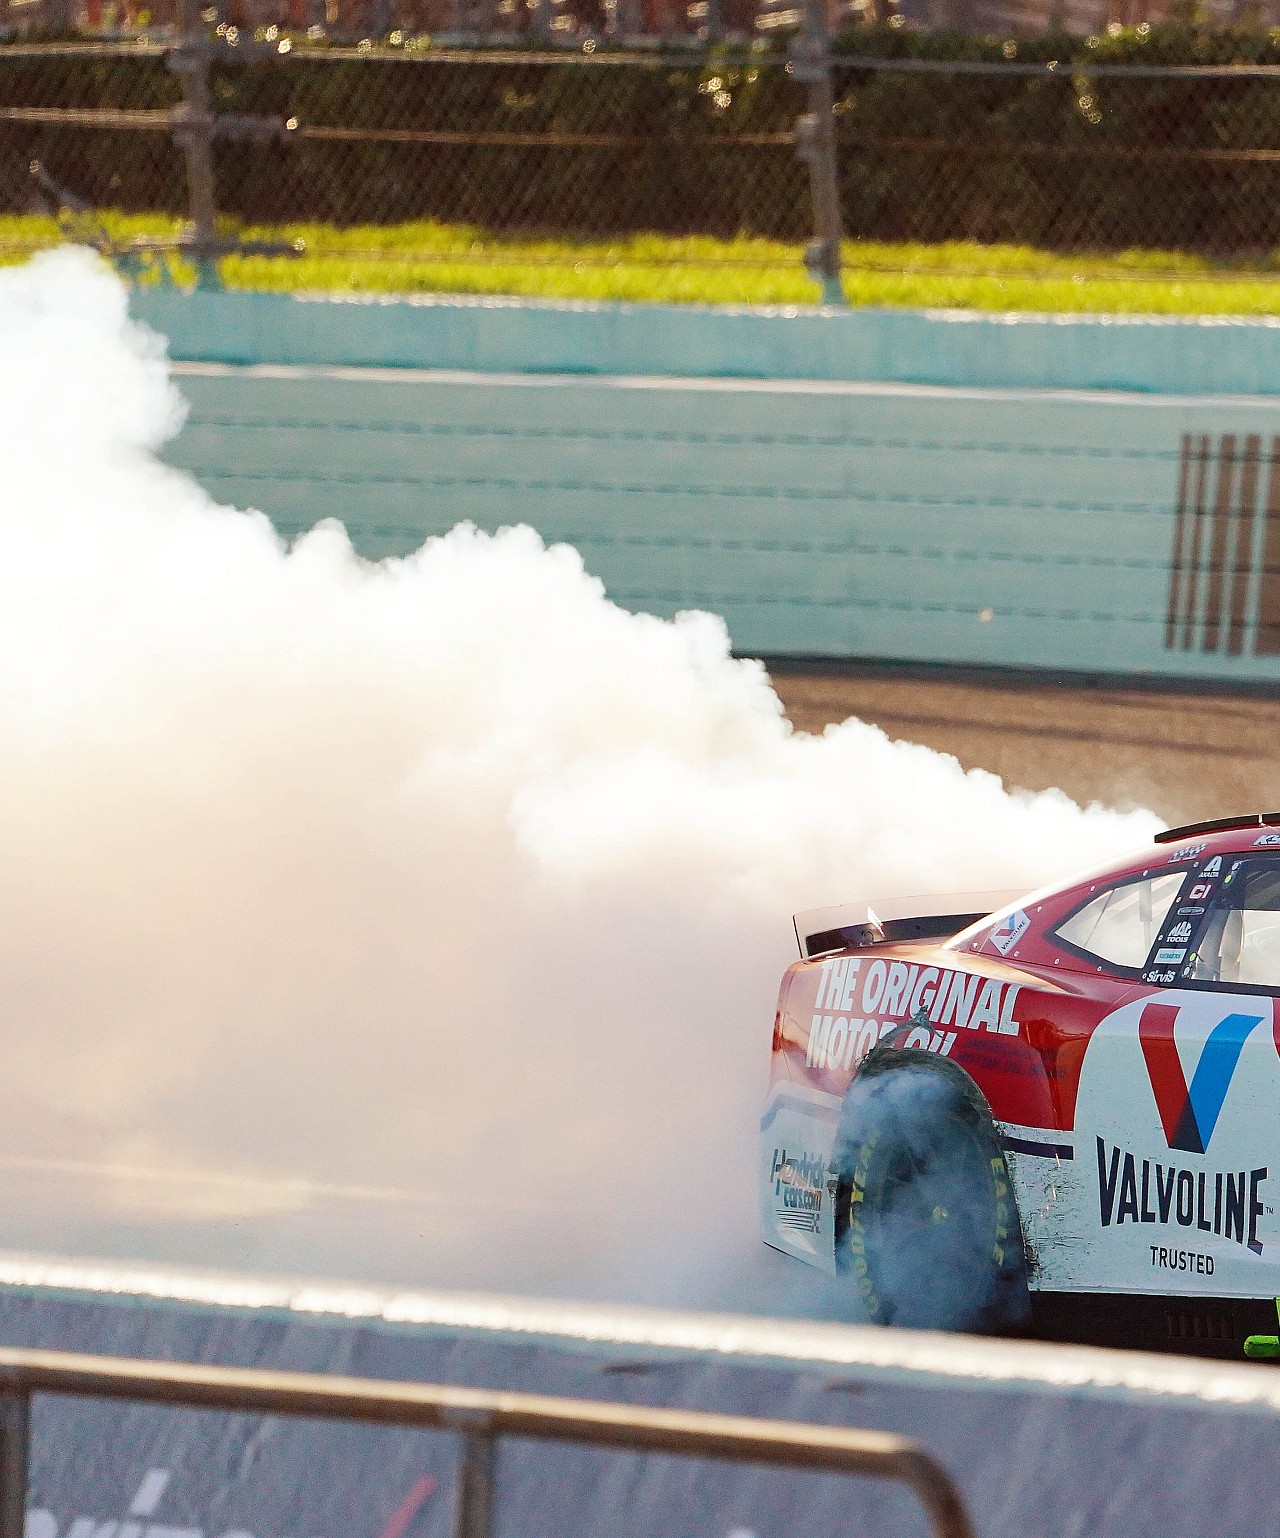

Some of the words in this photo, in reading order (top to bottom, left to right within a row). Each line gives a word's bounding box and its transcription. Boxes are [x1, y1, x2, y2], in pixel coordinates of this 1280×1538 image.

[1168, 921, 1192, 936] MAC
[815, 958, 862, 1012] THE
[861, 960, 1023, 1036] ORIGINAL
[1096, 1135, 1268, 1255] VALVOLINE
[1150, 1246, 1215, 1275] TRUSTED
